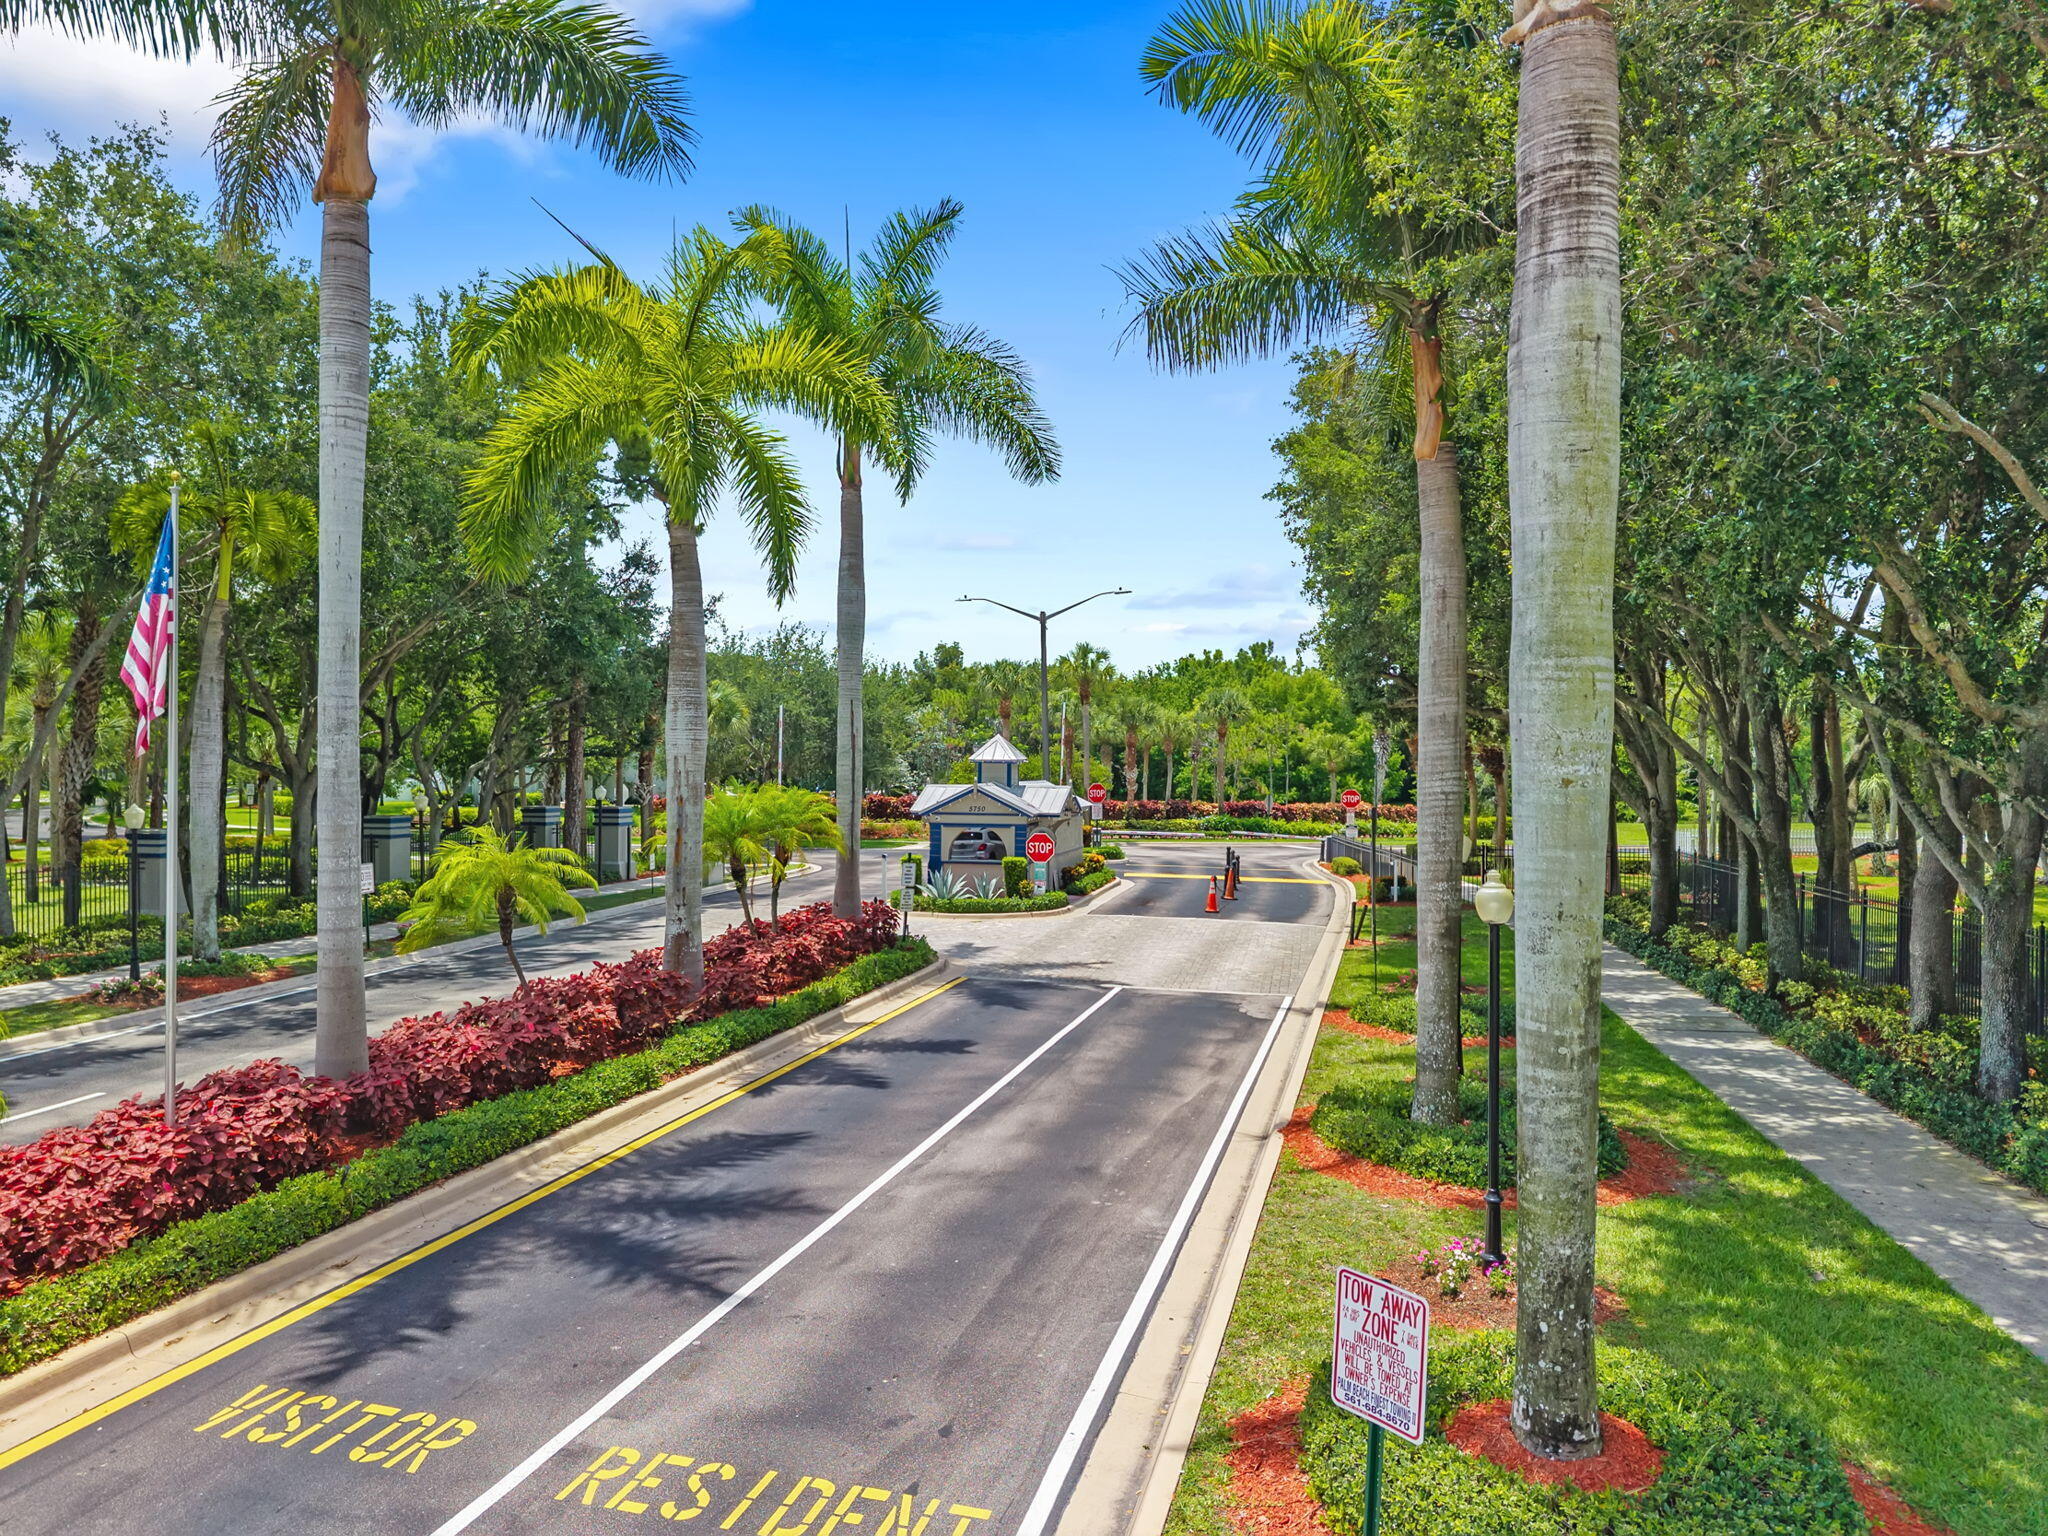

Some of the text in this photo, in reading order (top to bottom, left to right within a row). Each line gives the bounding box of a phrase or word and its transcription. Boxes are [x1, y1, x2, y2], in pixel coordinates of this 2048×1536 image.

[1089, 789, 1105, 798] STOP
[1342, 795, 1360, 803] STOP
[1028, 842, 1053, 854] STOP
[1343, 1274, 1421, 1329] TOW AWAY
[1353, 1330, 1405, 1365] UNAUTHORIZED
[1361, 1307, 1399, 1347] ZONE
[1340, 1337, 1418, 1384] VEHICLES & VESSELS
[1344, 1352, 1413, 1395] WILL BE TOWED AT
[1337, 1376, 1352, 1393] PALM
[1353, 1383, 1370, 1399] BEACH
[1370, 1392, 1389, 1410] FINEST
[1390, 1401, 1411, 1422] TOWING
[1344, 1365, 1376, 1391] OWNER'S
[1380, 1382, 1411, 1408] EXPENSE
[193, 1384, 478, 1474] VISITOR
[1344, 1392, 1410, 1431] 561-684-8670
[554, 1446, 993, 1536] RESIDENT
